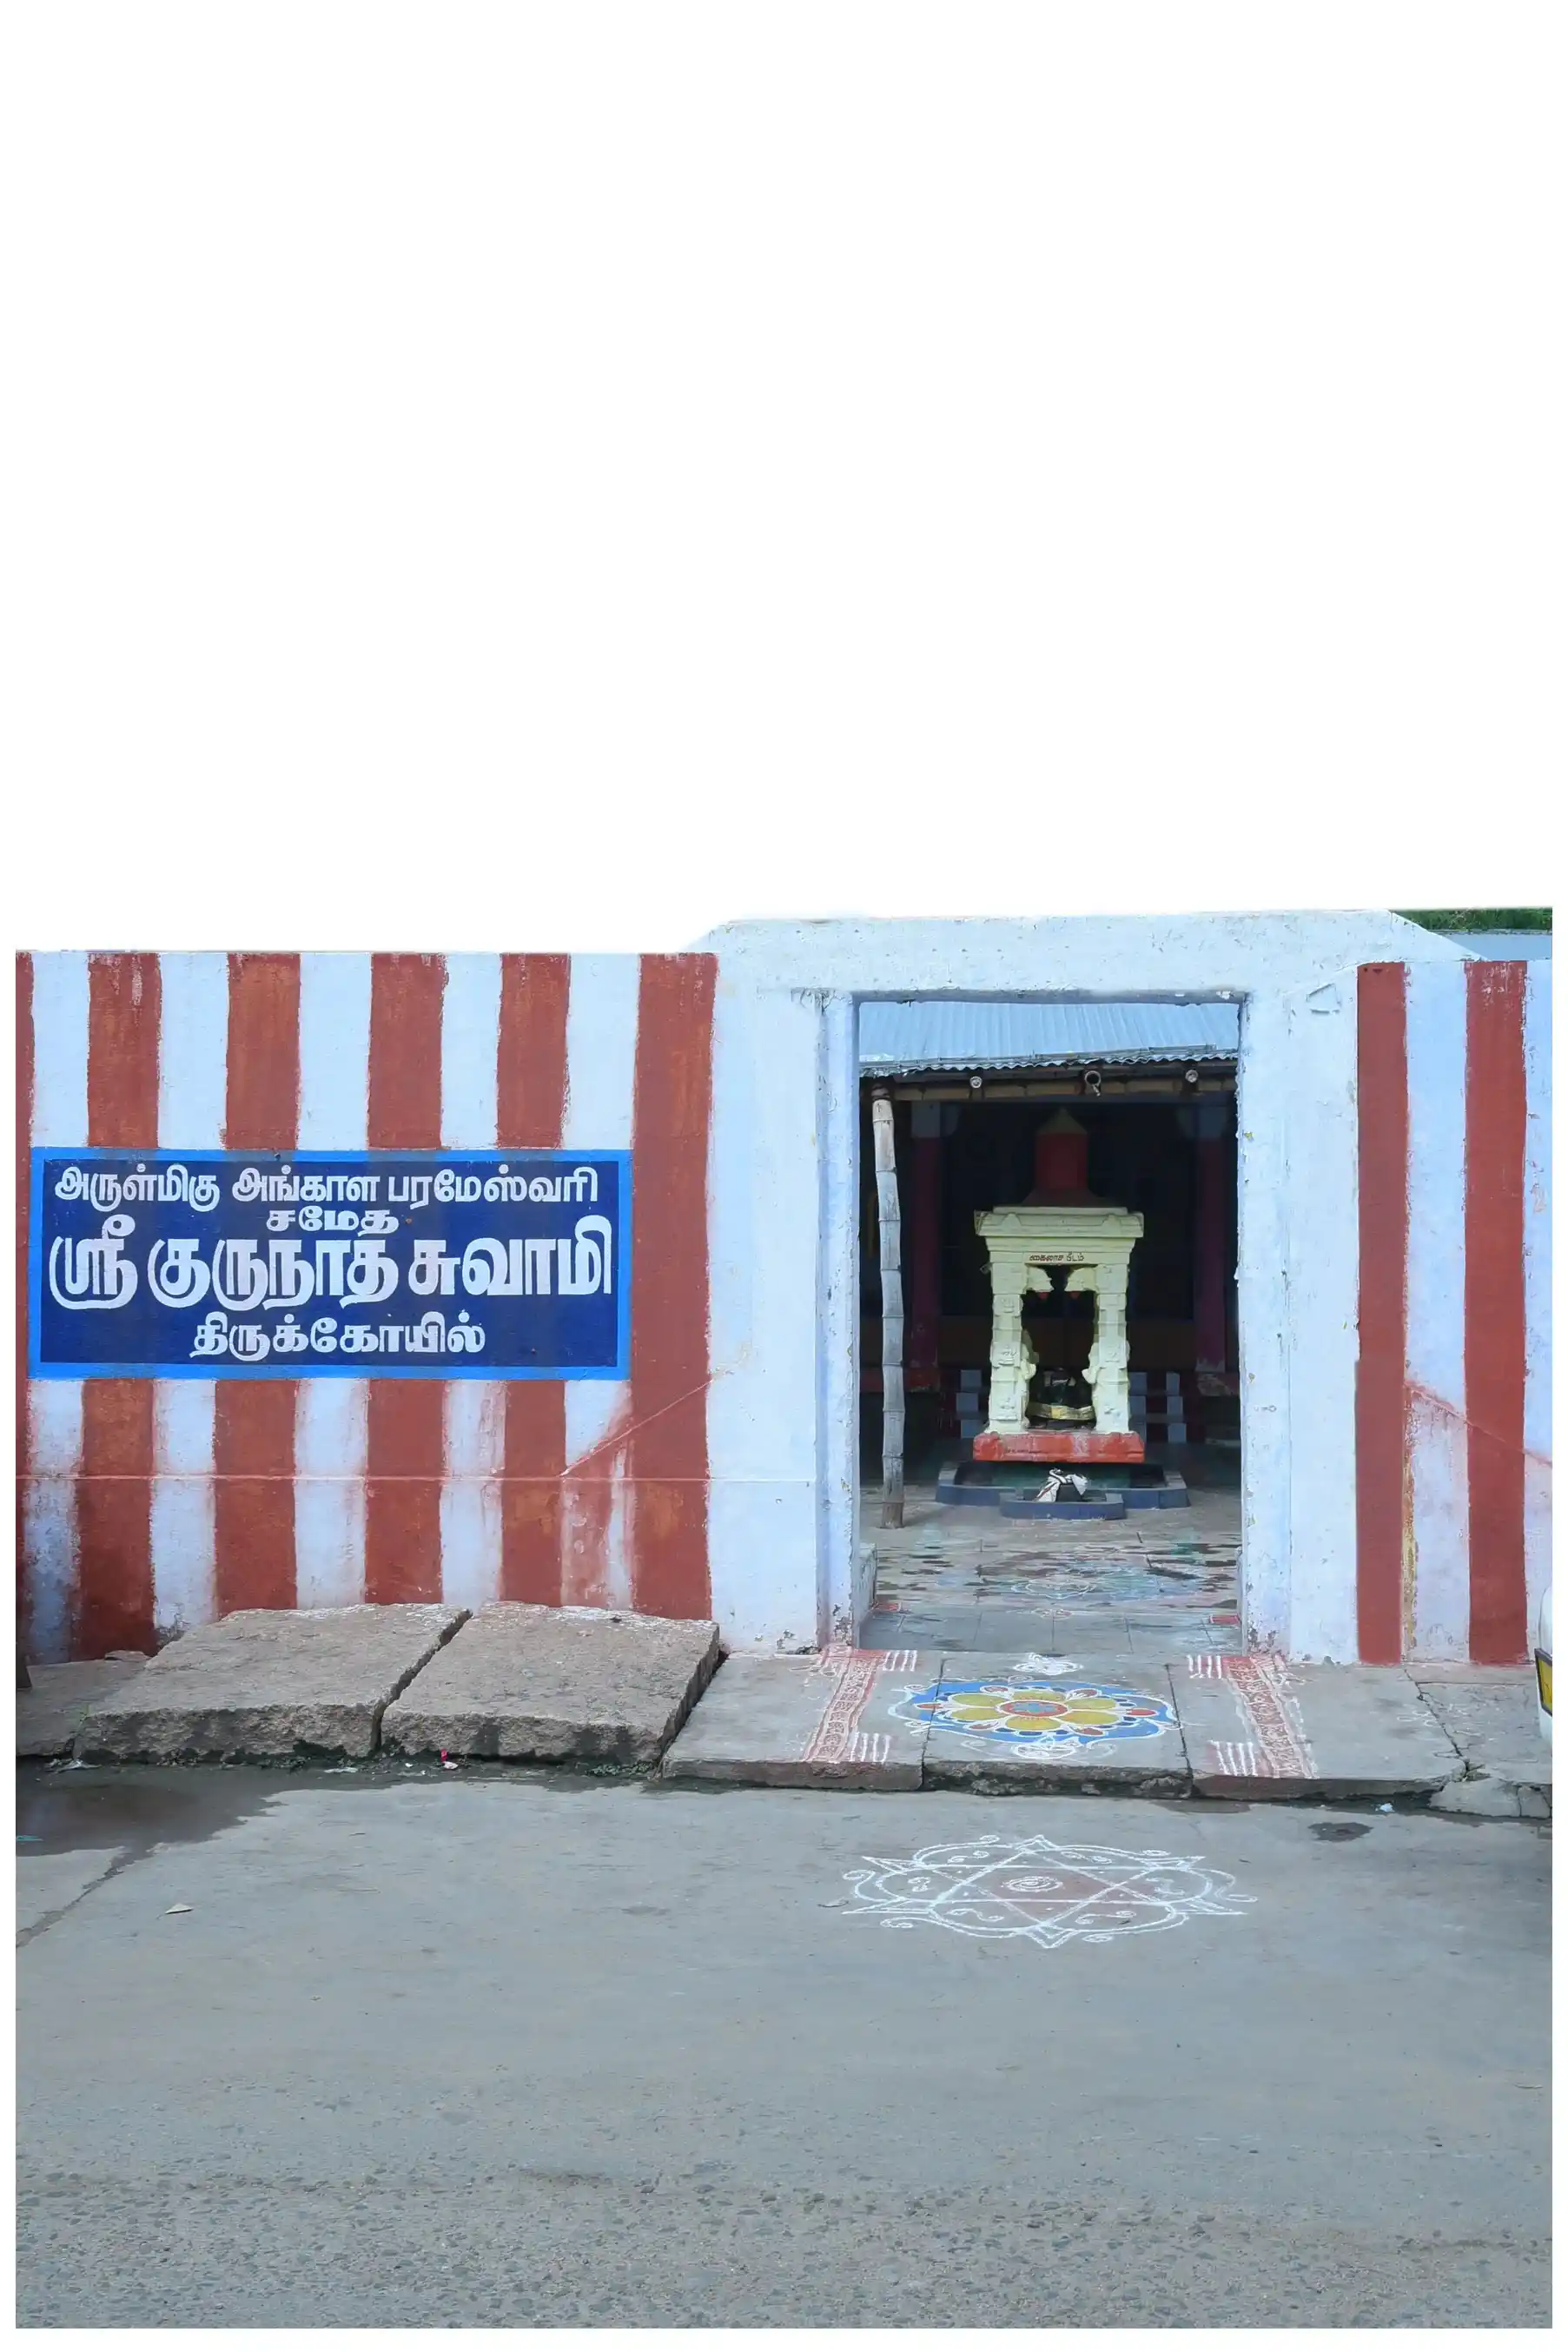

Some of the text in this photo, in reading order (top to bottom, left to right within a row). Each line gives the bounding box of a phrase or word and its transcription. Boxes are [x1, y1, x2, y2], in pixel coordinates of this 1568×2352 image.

[54, 1163, 599, 1212] அருள்மிகு அங்காள பரமேஸ்வரி
[266, 1205, 400, 1237] சமேத
[147, 1238, 399, 1311] குருநாத
[407, 1215, 612, 1296] சுவாமி
[189, 1309, 486, 1362] திருக்கோயில்
